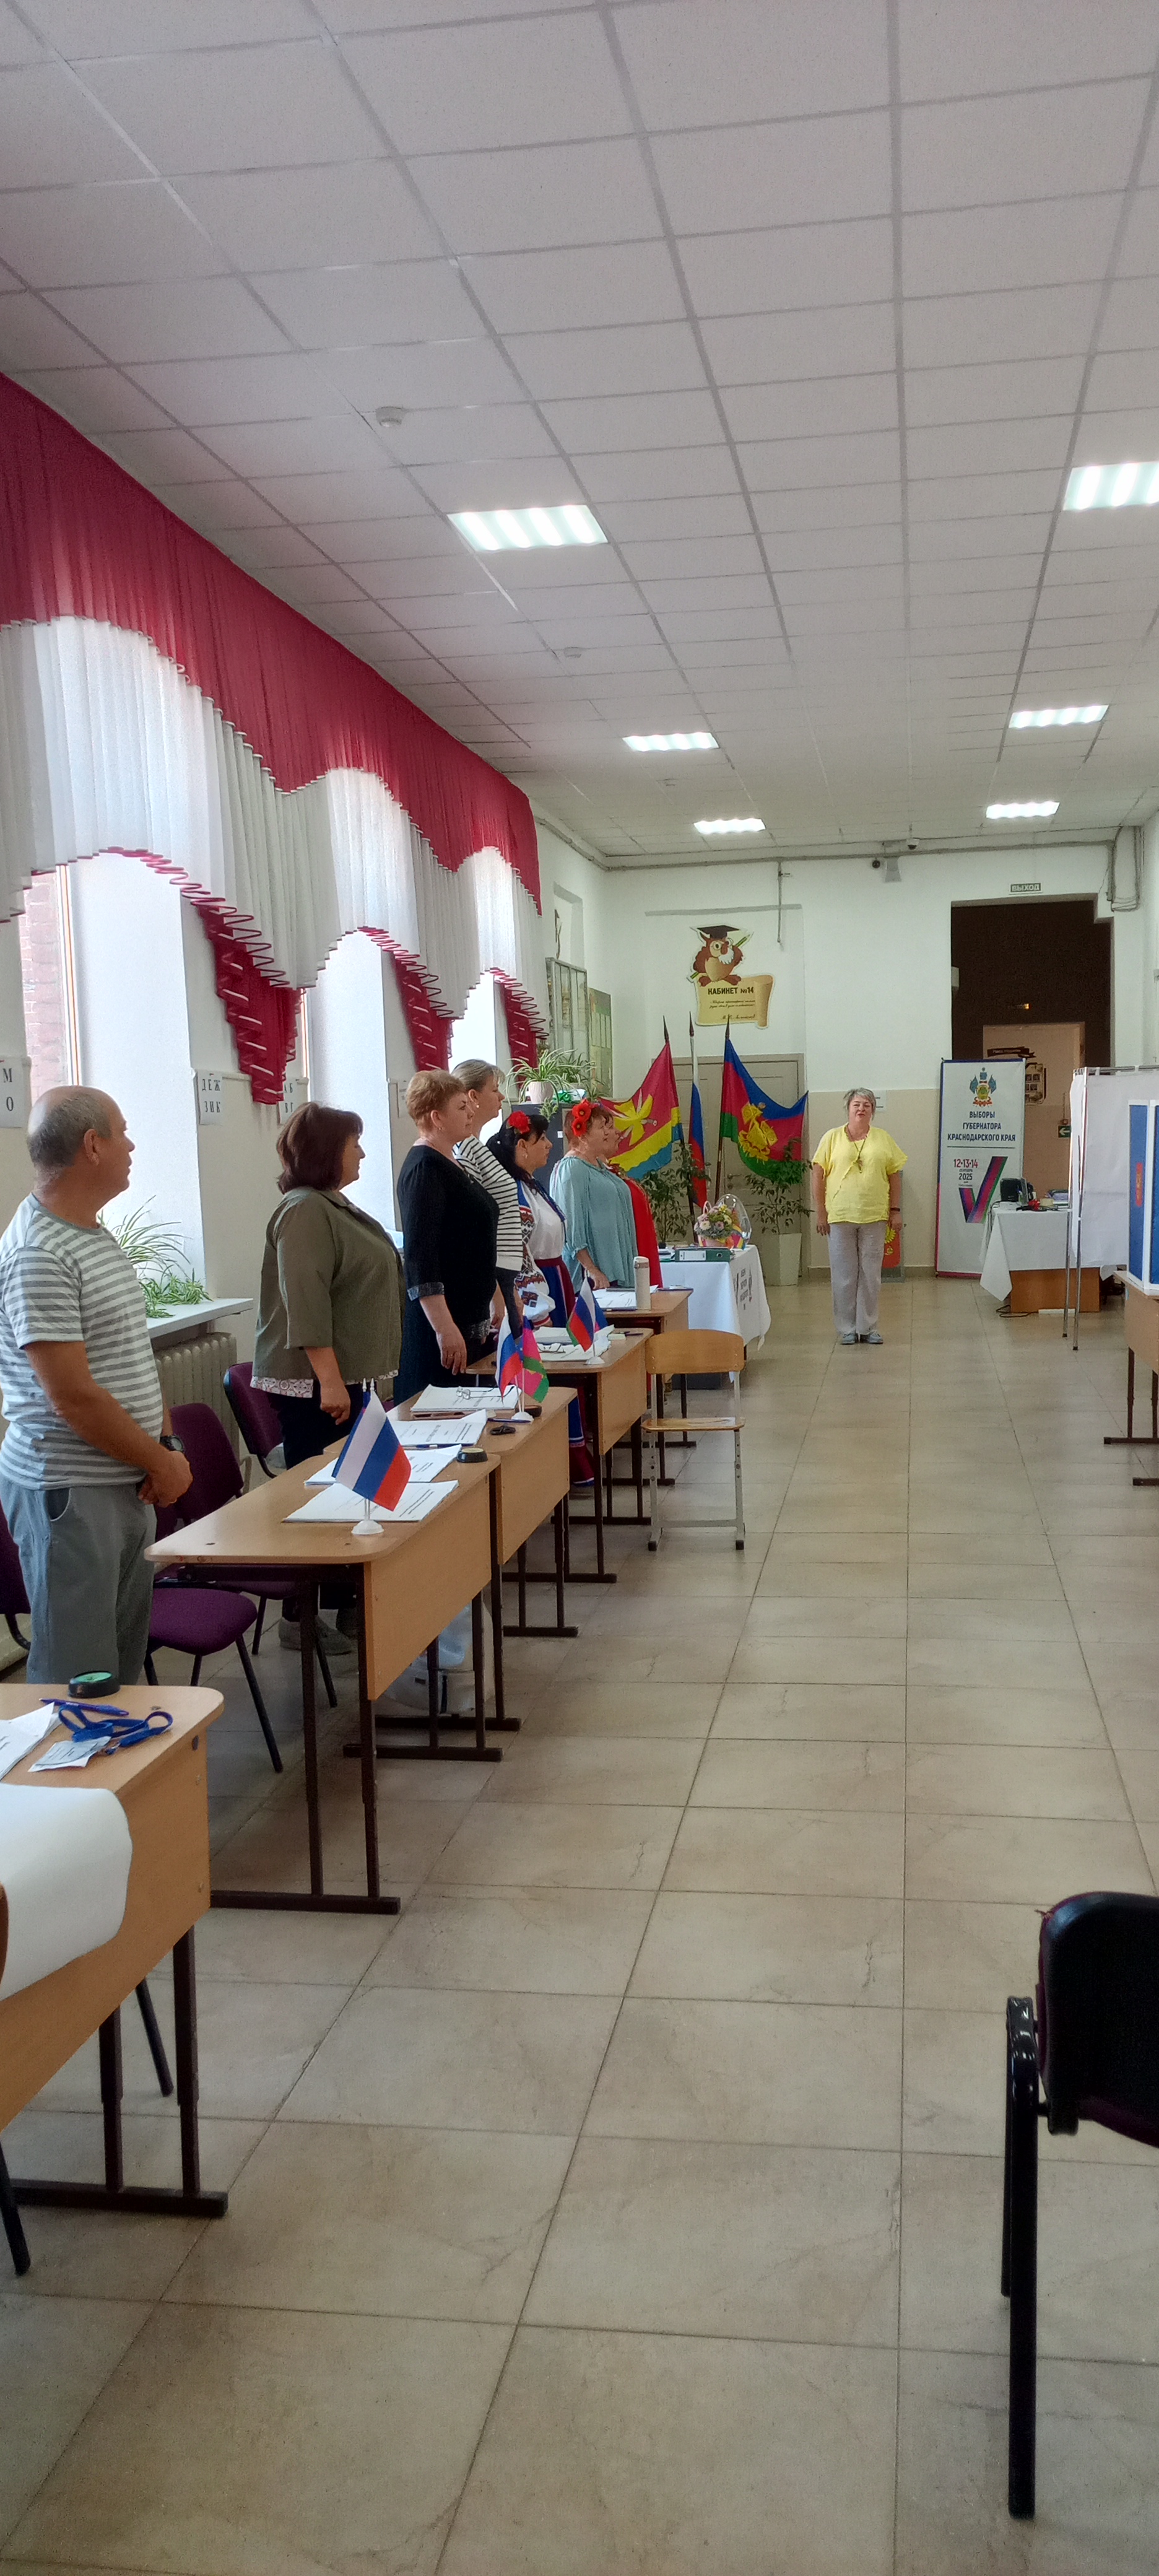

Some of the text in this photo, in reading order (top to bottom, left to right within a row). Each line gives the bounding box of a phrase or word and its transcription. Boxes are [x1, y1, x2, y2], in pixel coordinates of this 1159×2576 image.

[963, 1122, 1002, 1130] ГУБЕРНАТОРА
[947, 1133, 1016, 1142] КРАСНОДАРСКОГО КРАЯ
